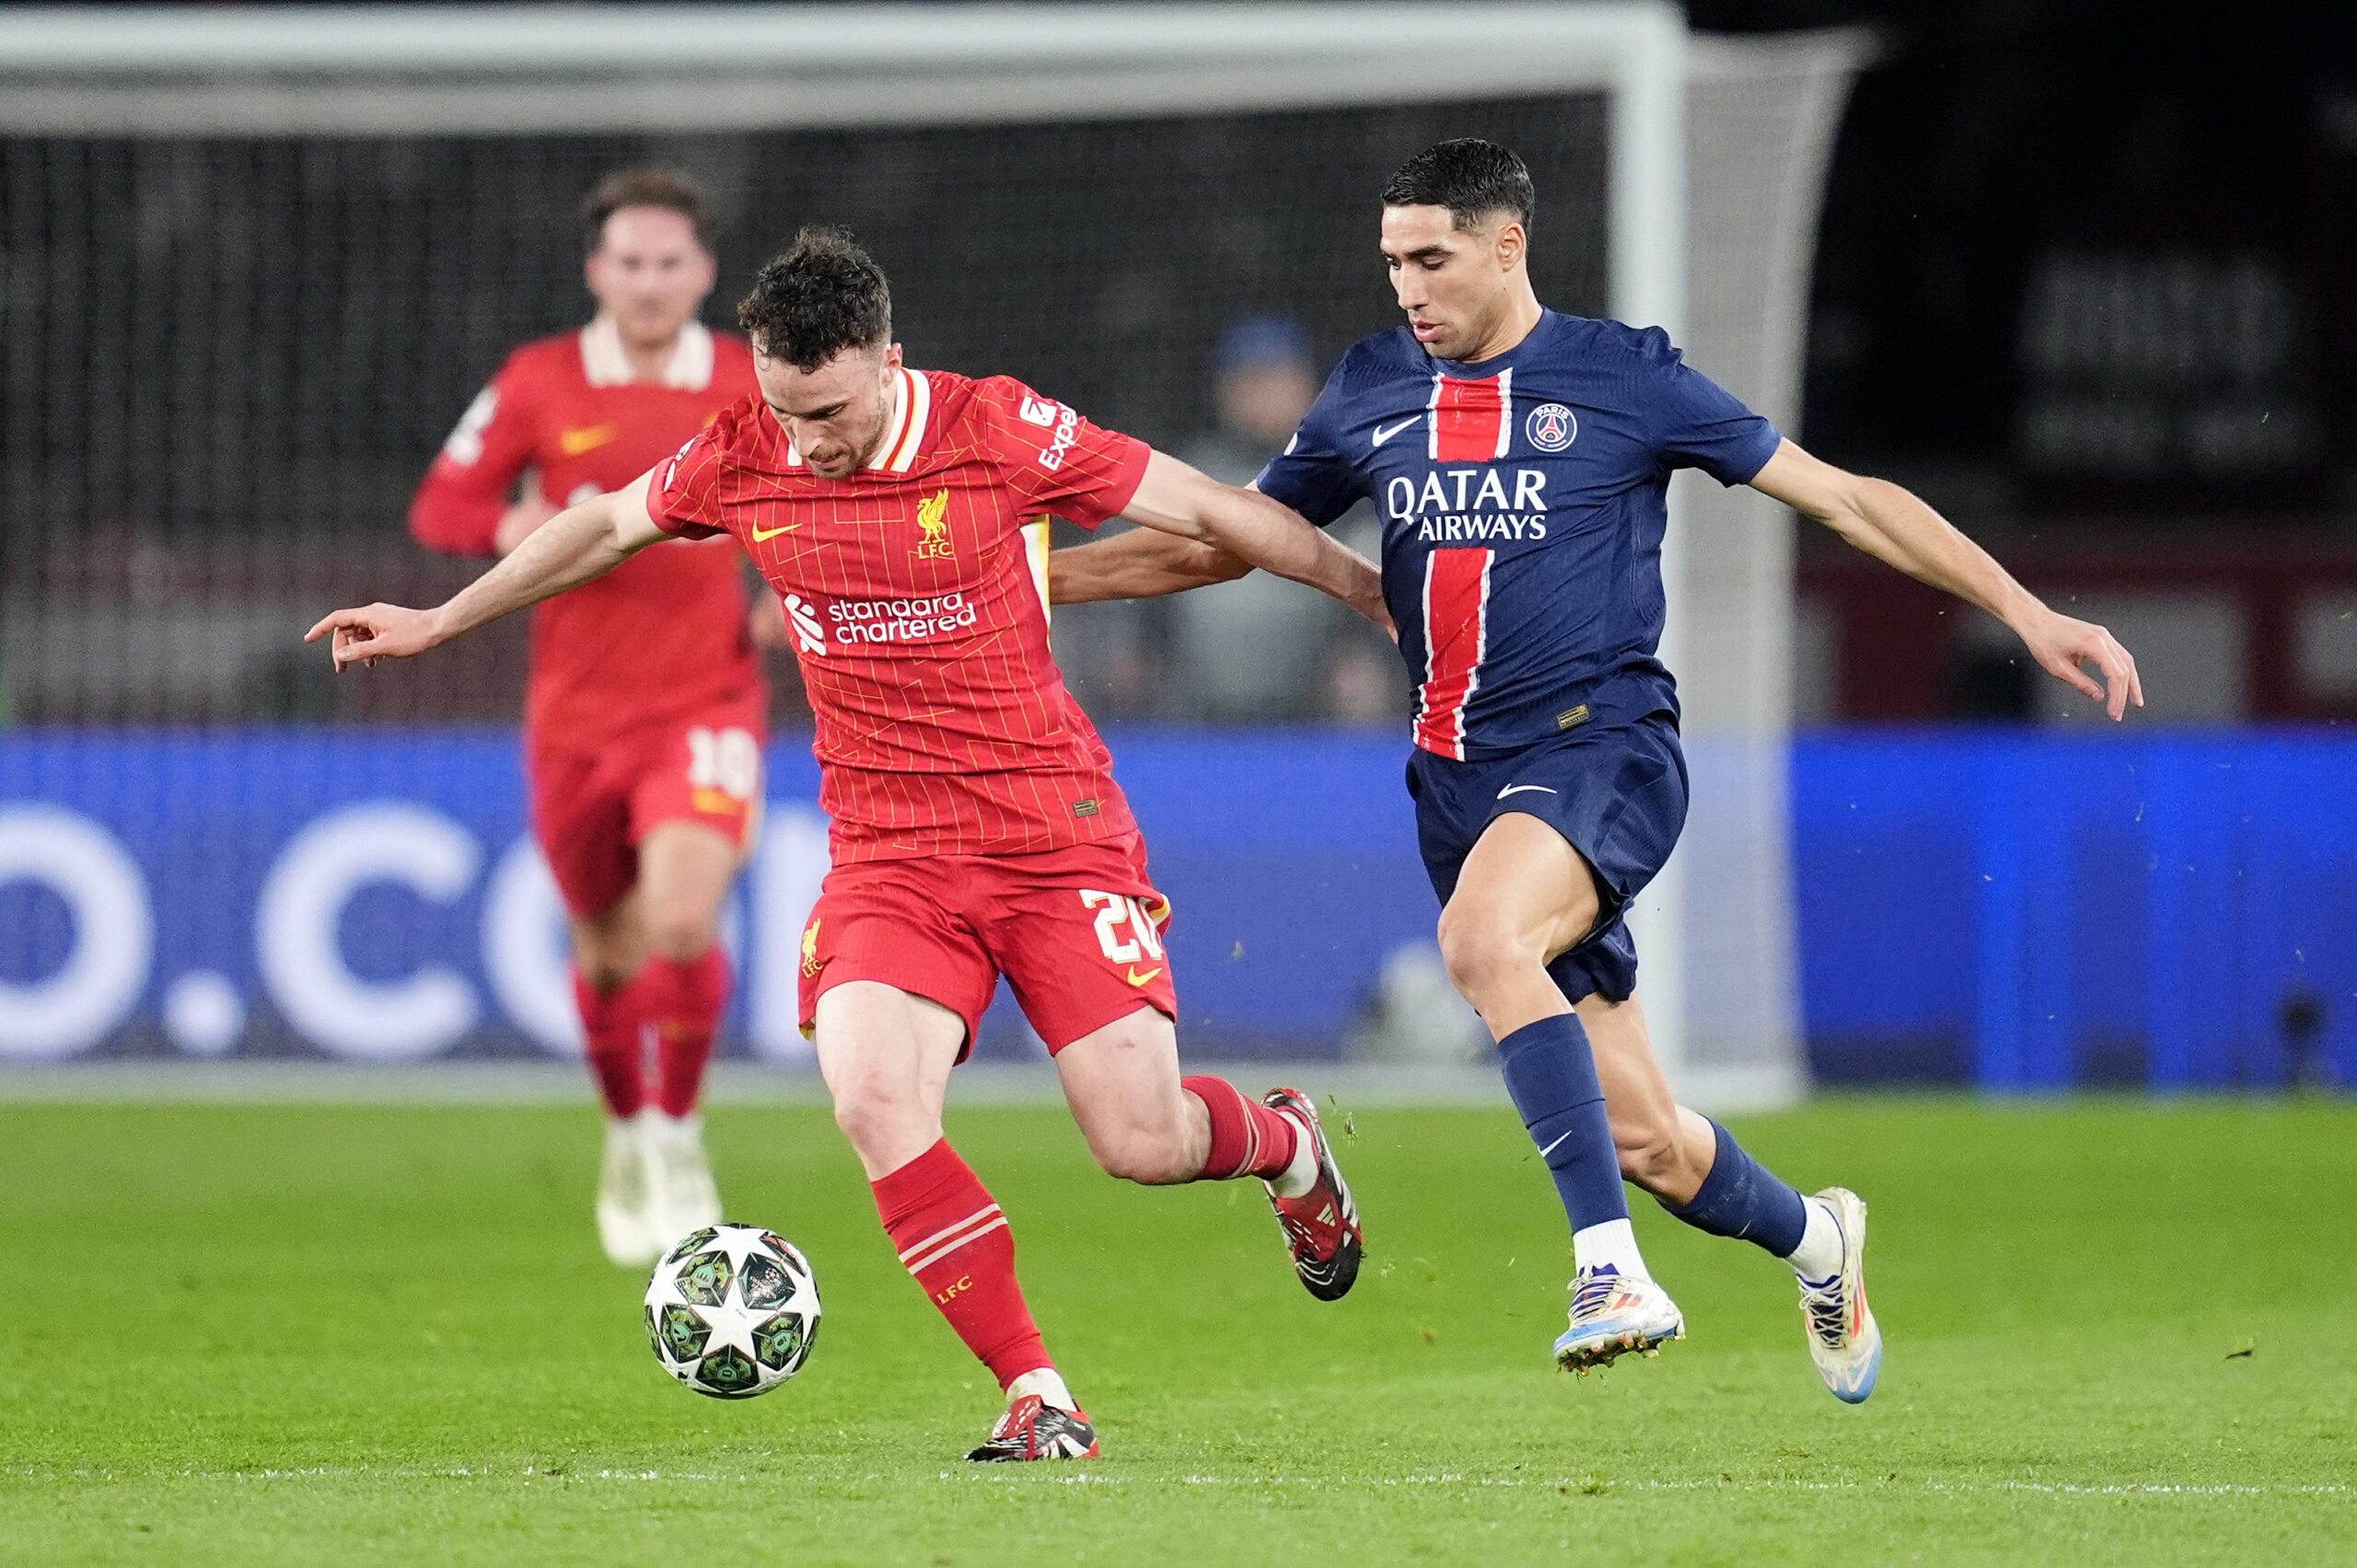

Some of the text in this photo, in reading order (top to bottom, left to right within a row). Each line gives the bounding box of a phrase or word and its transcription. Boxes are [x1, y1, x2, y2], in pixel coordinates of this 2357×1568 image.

[1536, 406, 1569, 419] PARIS
[1387, 468, 1548, 525] QATAR
[1418, 514, 1547, 541] AIRWAYS
[829, 592, 963, 621] standard
[835, 602, 977, 644] chartered
[936, 1275, 972, 1304] LFC
